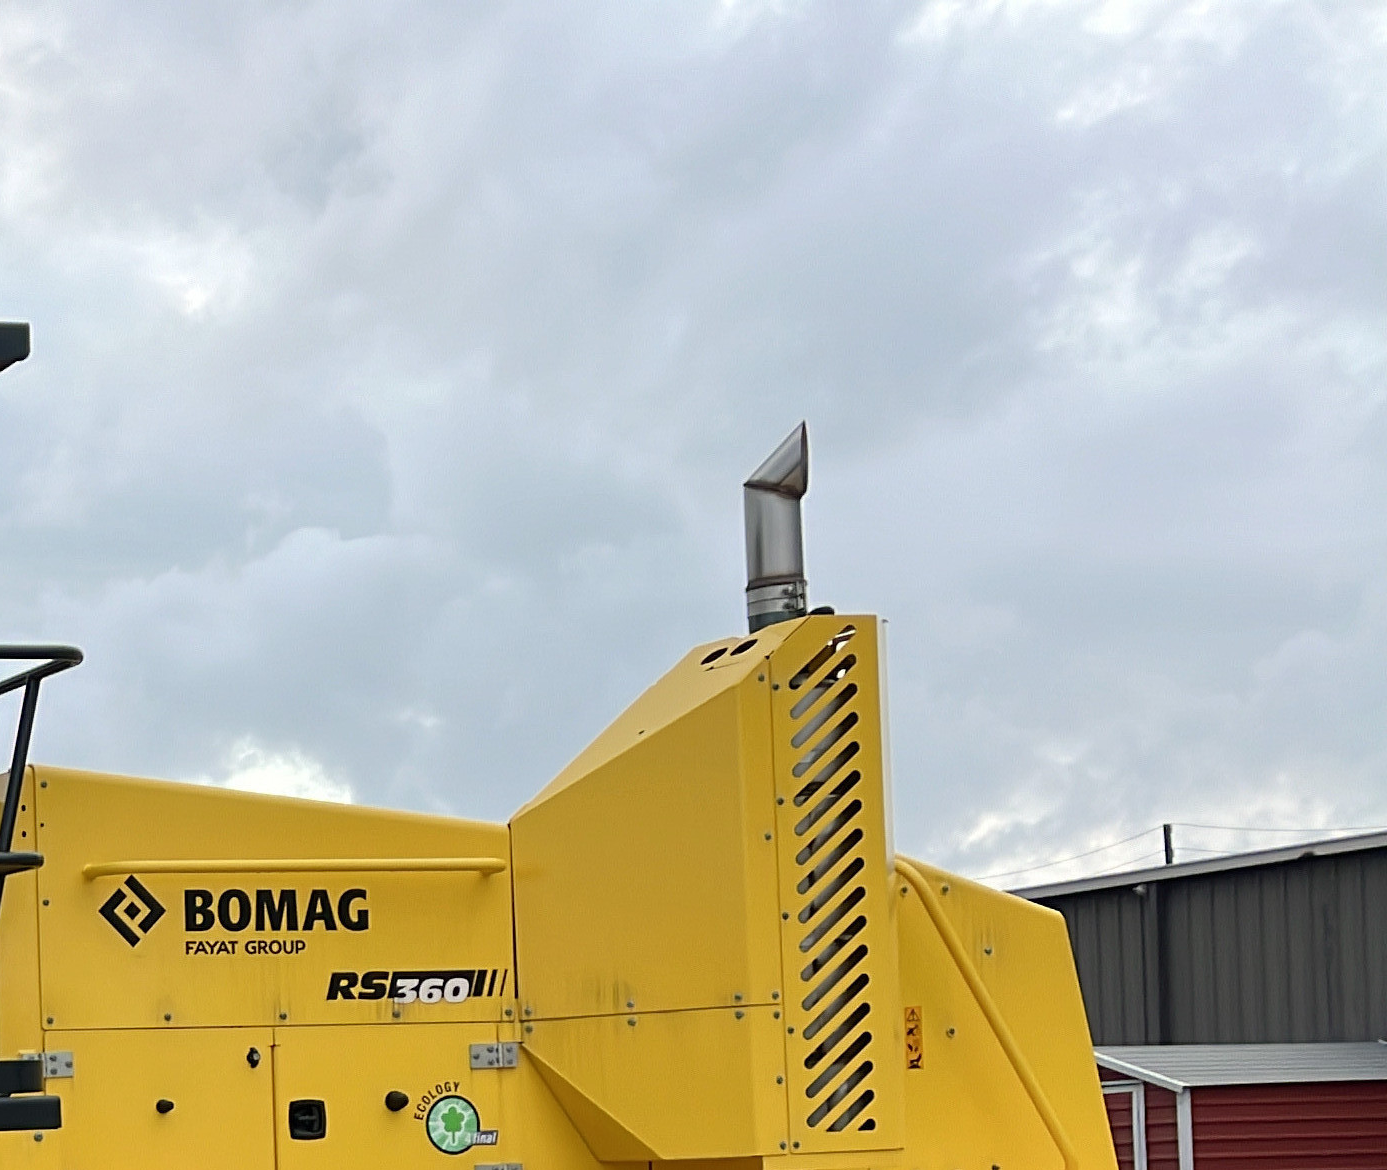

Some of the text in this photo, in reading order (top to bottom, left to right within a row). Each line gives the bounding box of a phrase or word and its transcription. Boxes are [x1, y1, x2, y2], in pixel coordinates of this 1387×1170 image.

[184, 888, 369, 932] BOMAG
[185, 939, 306, 955] FAYAT GROUP
[327, 971, 470, 1004] RS360
[413, 1081, 460, 1121] ECOLOGY
